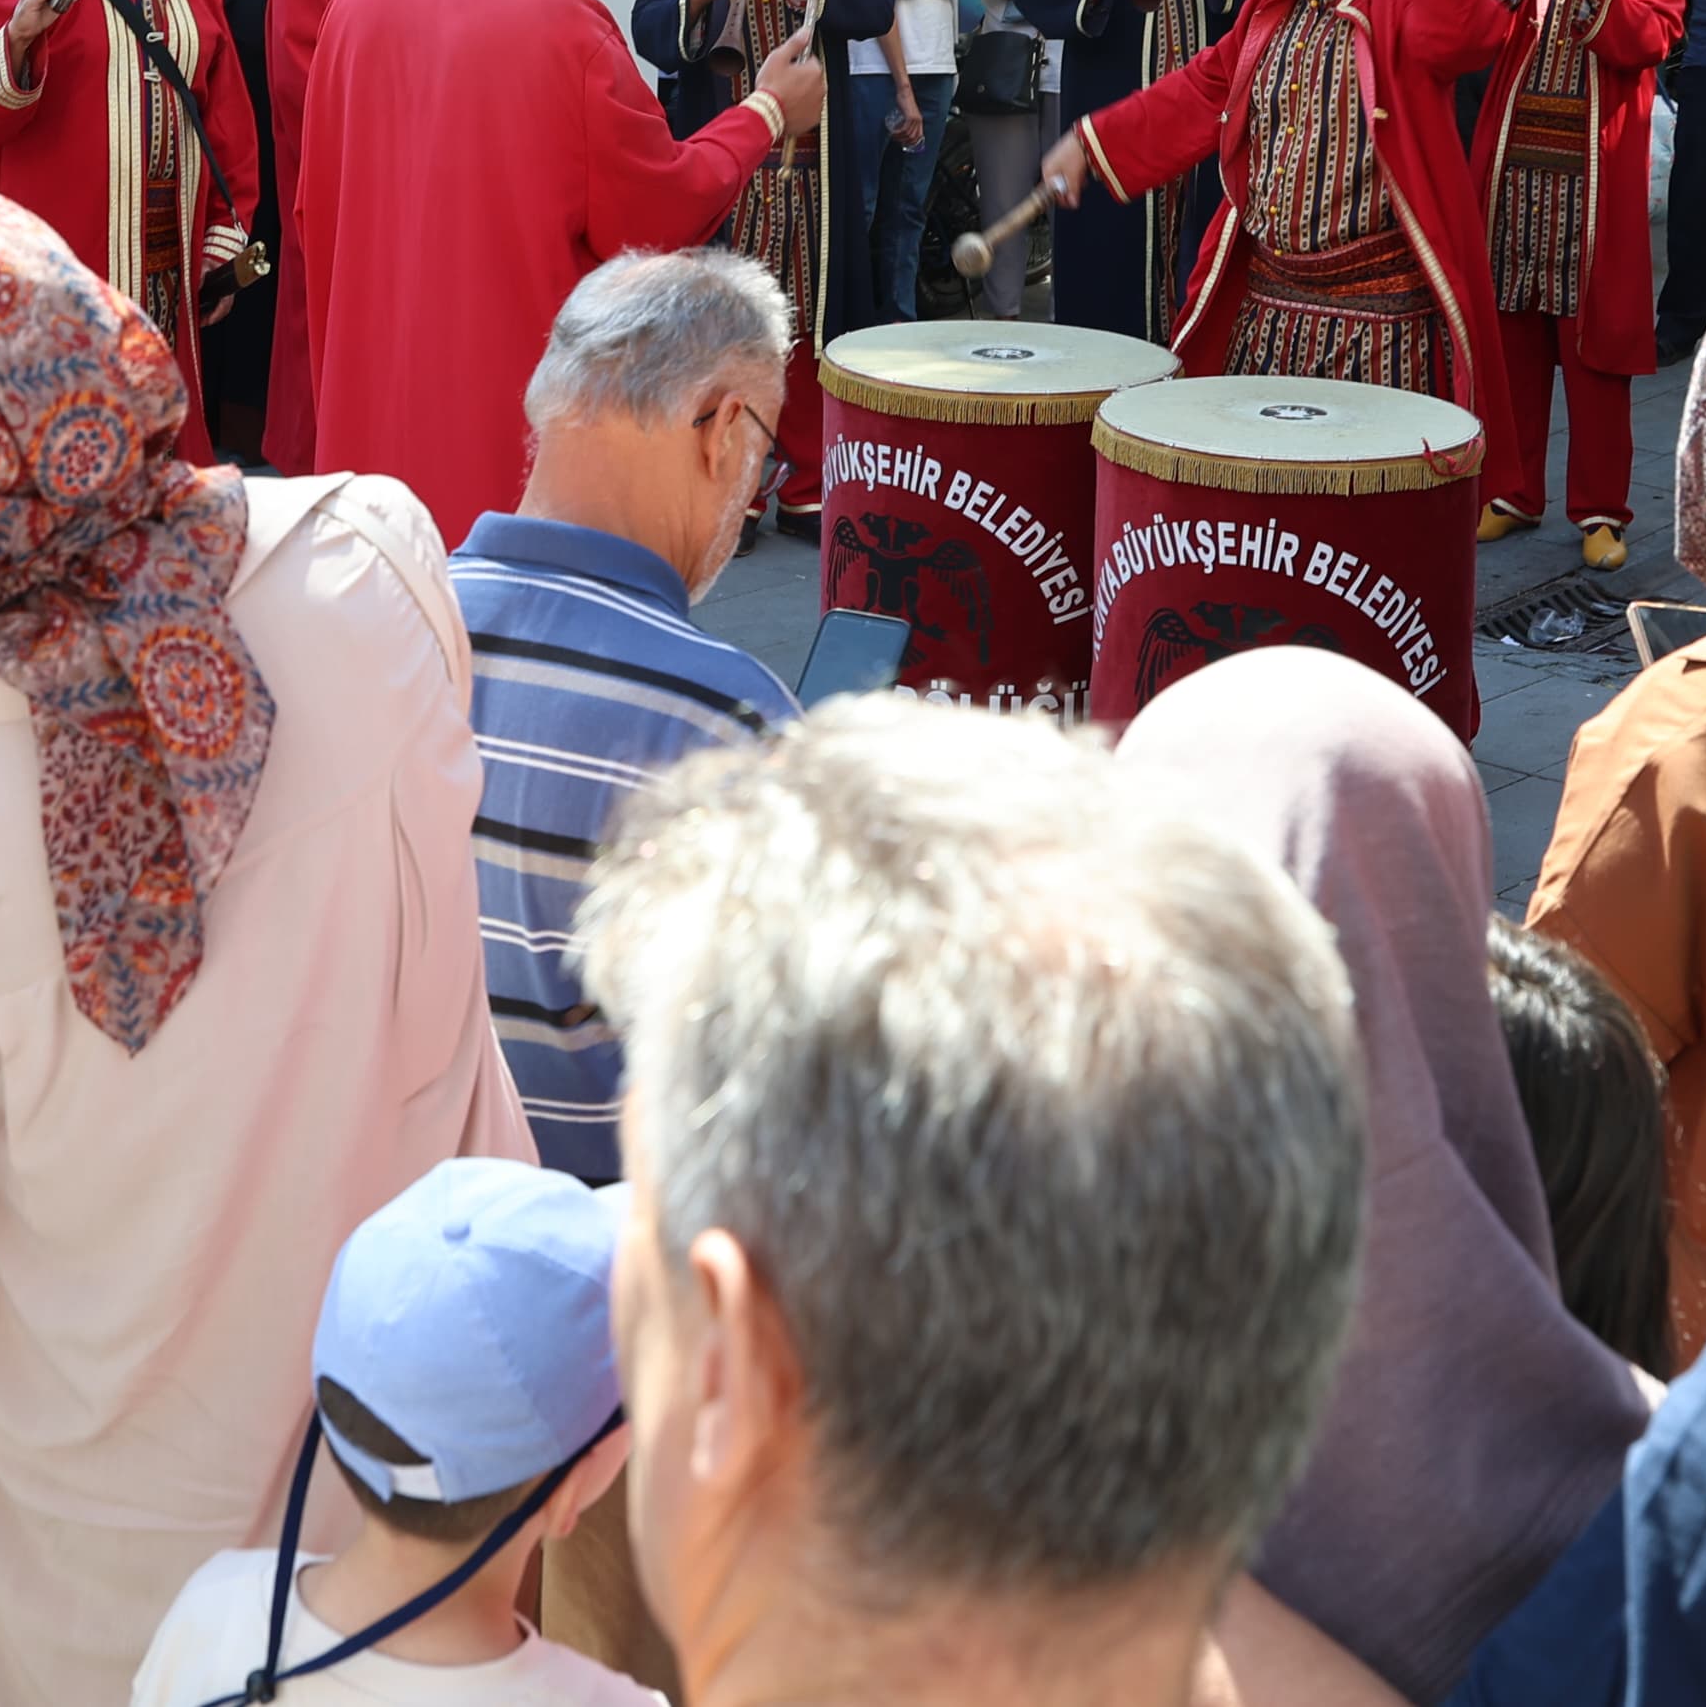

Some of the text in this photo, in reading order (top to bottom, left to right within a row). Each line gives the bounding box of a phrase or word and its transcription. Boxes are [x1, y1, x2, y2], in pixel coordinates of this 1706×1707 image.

[945, 469, 1090, 626] BELEDİYESİ
[1112, 512, 1300, 586] BÜYÜKŞEHİR
[1303, 540, 1449, 698] BELEDİYESİ
